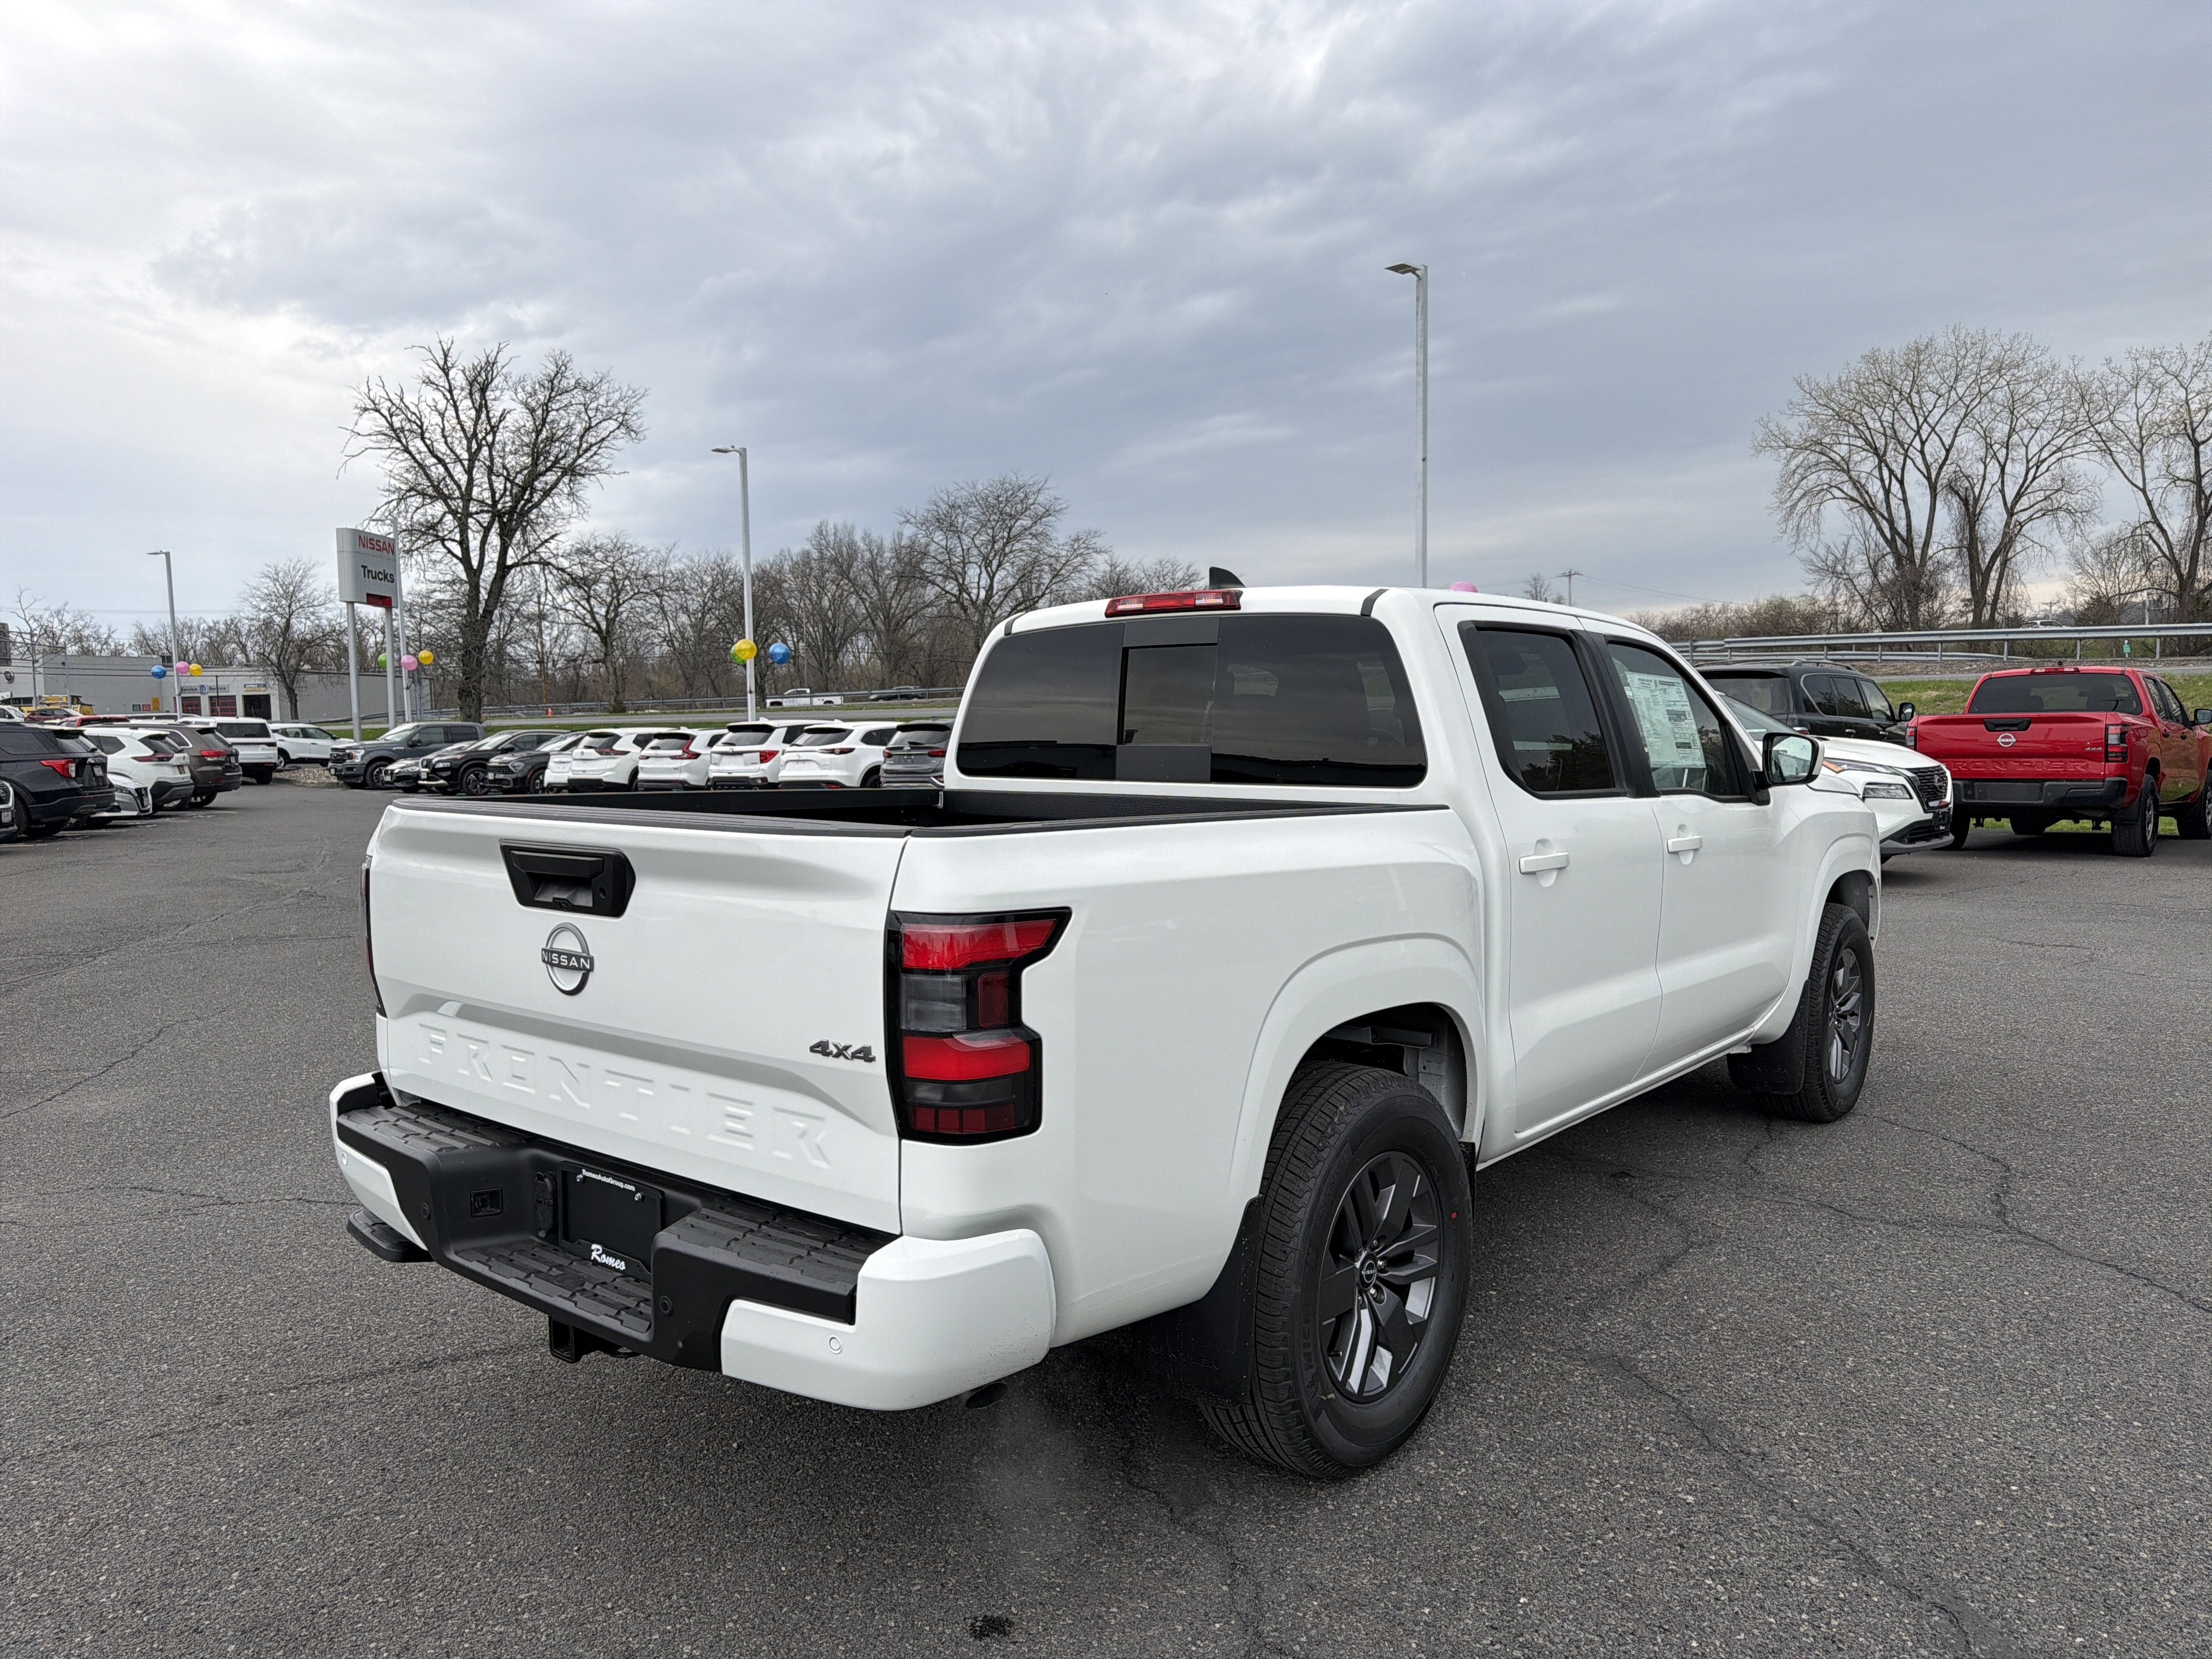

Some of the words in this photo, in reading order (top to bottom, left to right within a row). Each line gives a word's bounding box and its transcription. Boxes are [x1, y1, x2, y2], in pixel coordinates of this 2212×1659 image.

[358, 535, 395, 556] NISSAN
[361, 564, 395, 584] Trucks
[541, 950, 590, 969] NISSAN
[418, 1023, 831, 1170] FRONTIER
[582, 1169, 636, 1192] RomeoAutoGroup.com
[591, 1244, 626, 1271] Romeo
